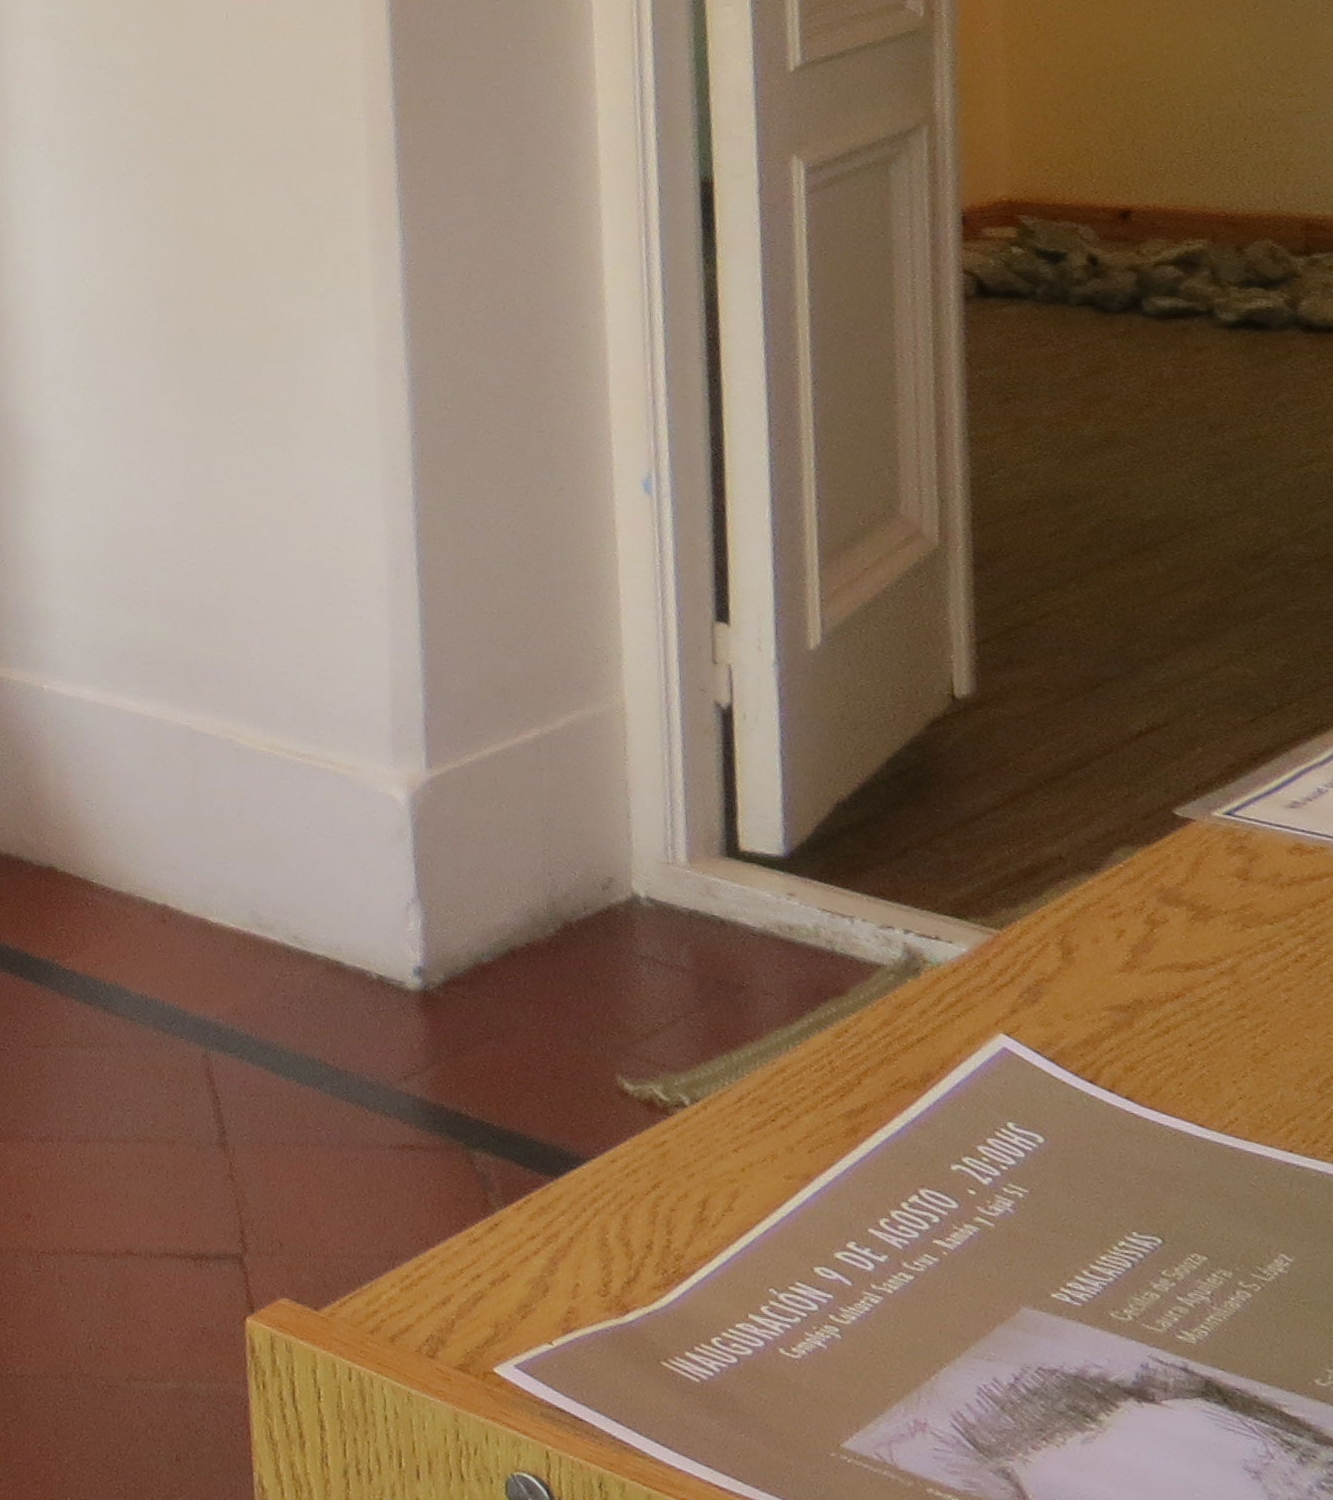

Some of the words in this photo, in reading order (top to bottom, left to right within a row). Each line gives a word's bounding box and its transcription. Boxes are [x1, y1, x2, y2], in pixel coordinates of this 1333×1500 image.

[660, 1281, 835, 1383] INAUGURACIÓN
[813, 1266, 853, 1287] 9
[834, 1241, 889, 1272] DE
[868, 1187, 960, 1250] AGOSTO
[950, 1120, 1045, 1186] 20:00HS
[1050, 1231, 1165, 1307] PARACAIDISTAS
[779, 1323, 843, 1360] Complejo
[828, 1290, 884, 1325] Cultural
[870, 1271, 915, 1294] Santa
[901, 1253, 940, 1272] Cruz
[1141, 1303, 1189, 1333] Laura
